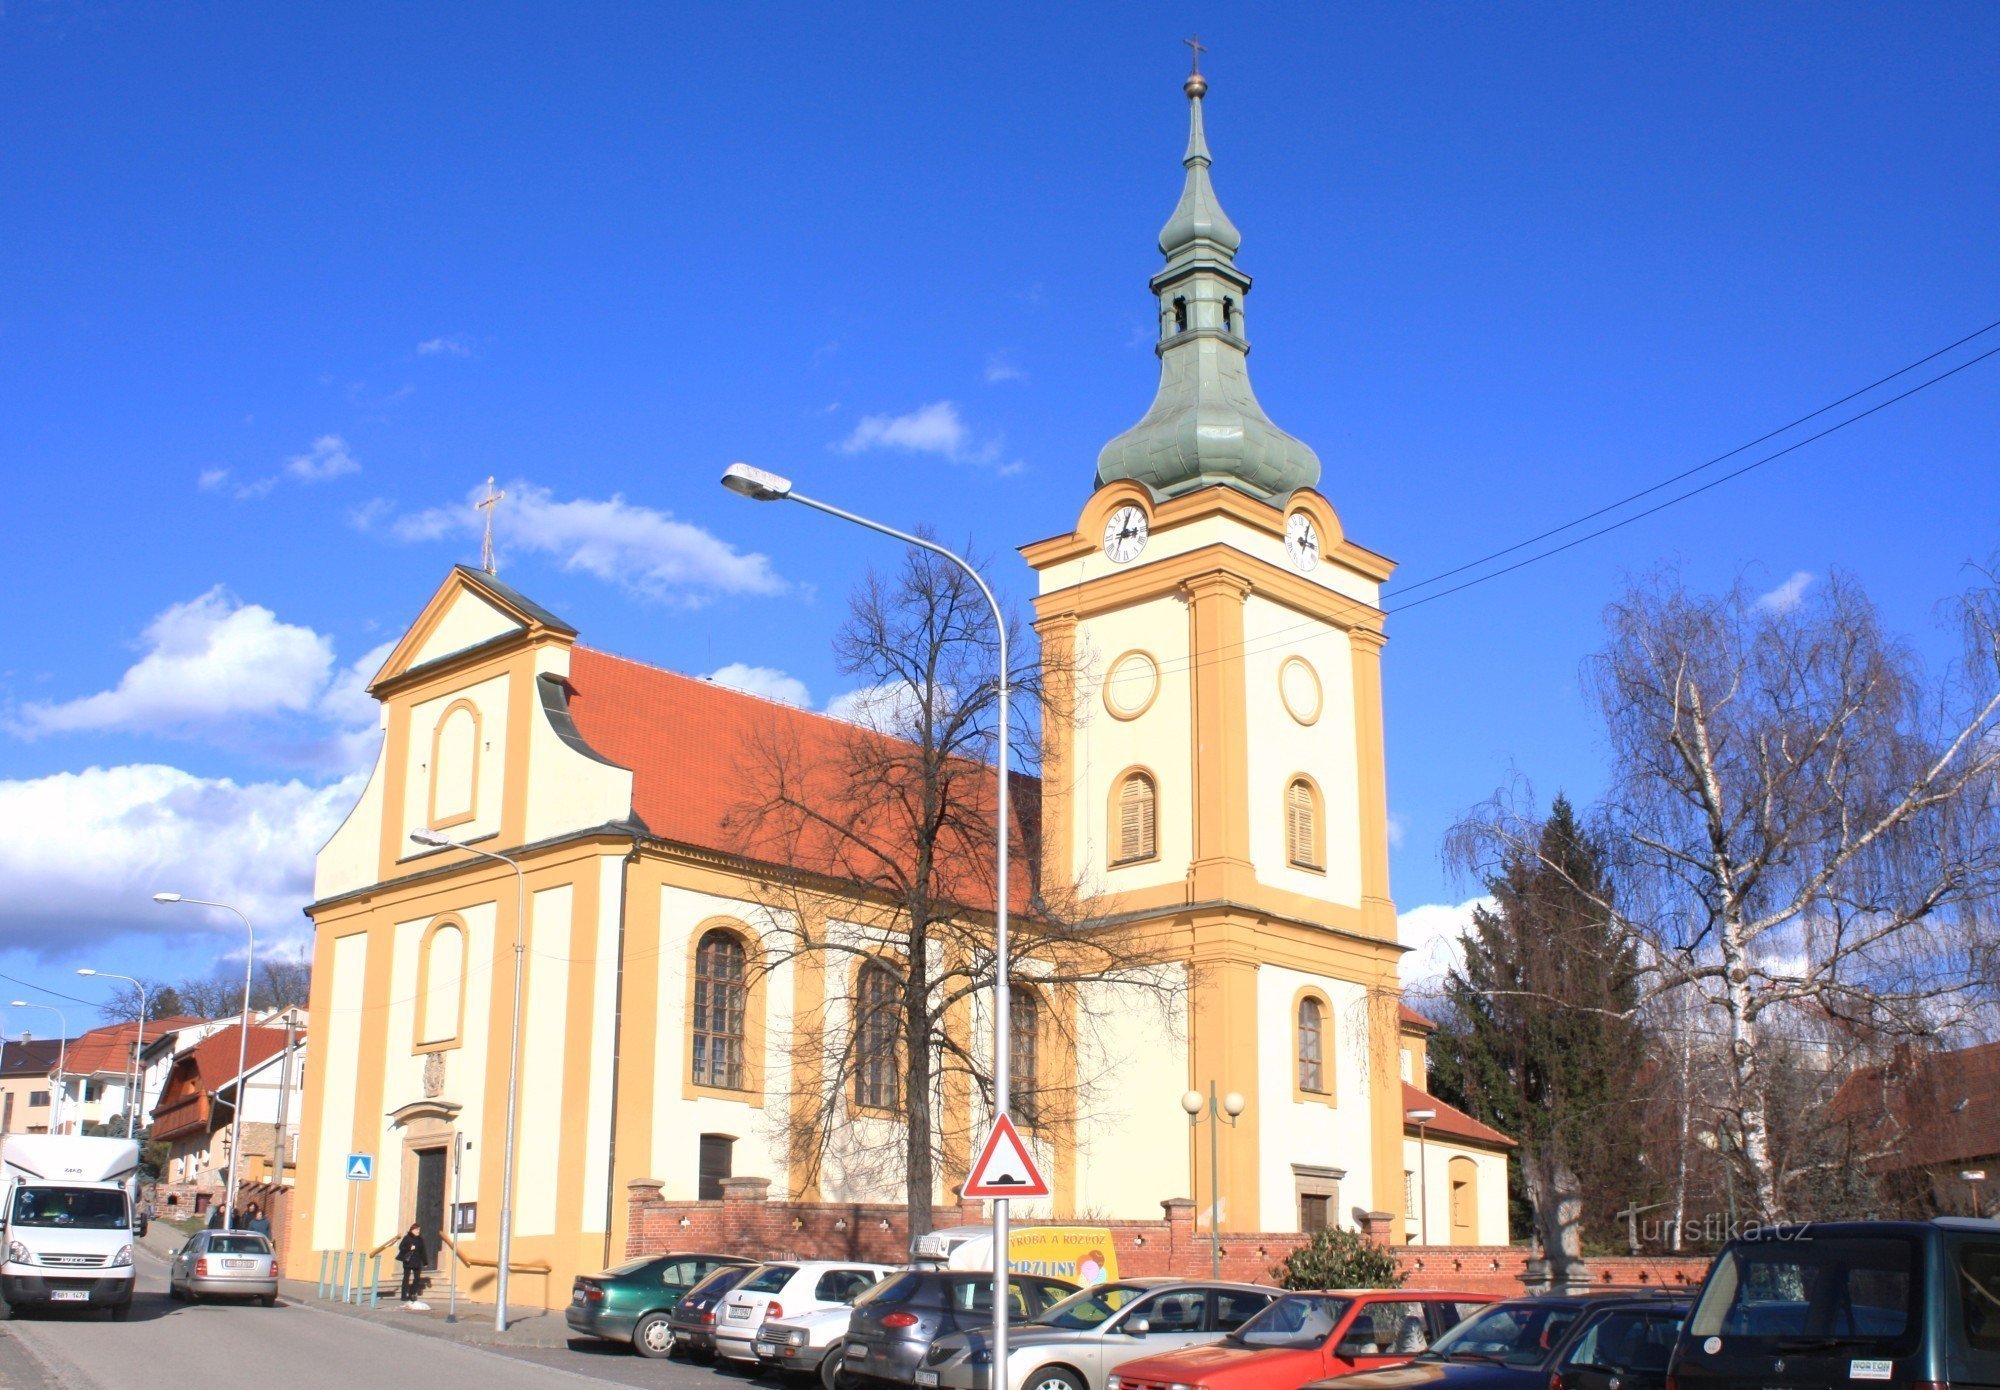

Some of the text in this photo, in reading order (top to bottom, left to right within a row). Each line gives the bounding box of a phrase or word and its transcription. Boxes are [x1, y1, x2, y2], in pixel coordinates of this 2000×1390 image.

[1052, 1236, 1059, 1244] A
[1063, 1235, 1106, 1245] ROZVOZ
[1008, 1261, 1075, 1276] MRZLINY
[1853, 1361, 1890, 1370] NORTON
